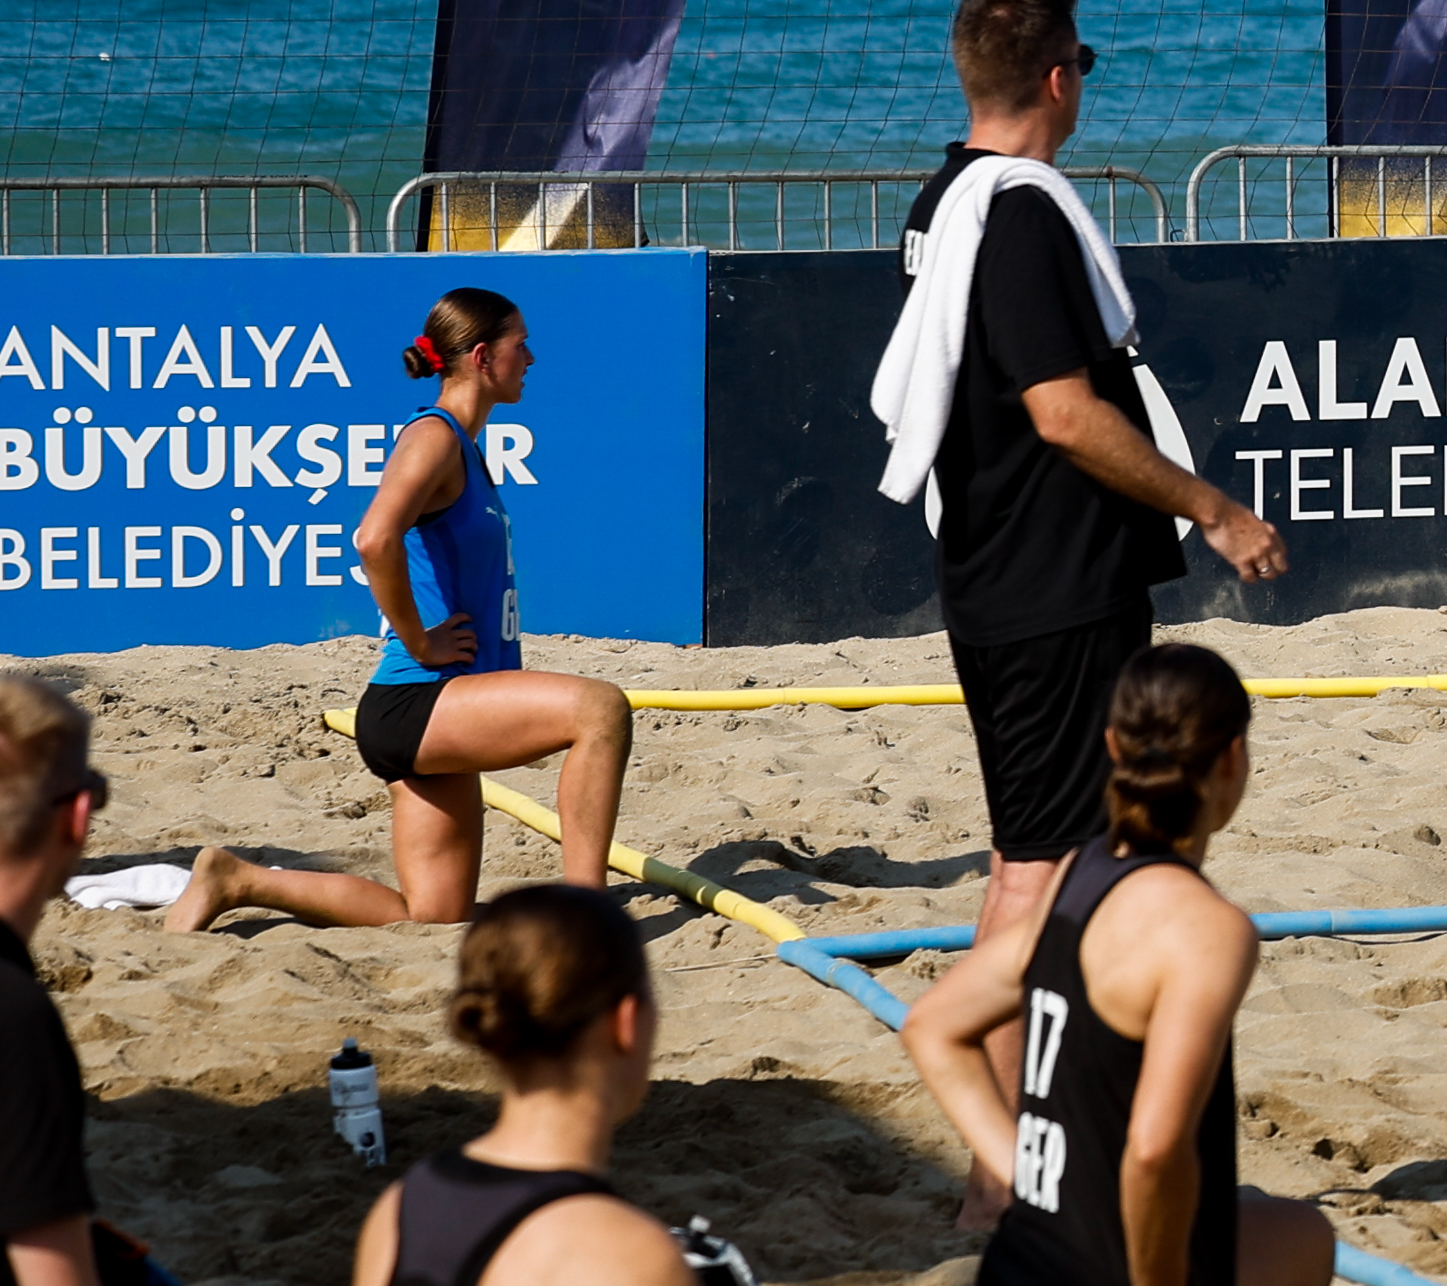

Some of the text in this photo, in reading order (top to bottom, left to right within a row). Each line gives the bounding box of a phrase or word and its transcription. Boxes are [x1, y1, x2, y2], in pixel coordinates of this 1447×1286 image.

[0, 323, 351, 391] ANTALYA
[0, 406, 538, 505] BÜYÜKŞER
[1025, 988, 1069, 1099] 17
